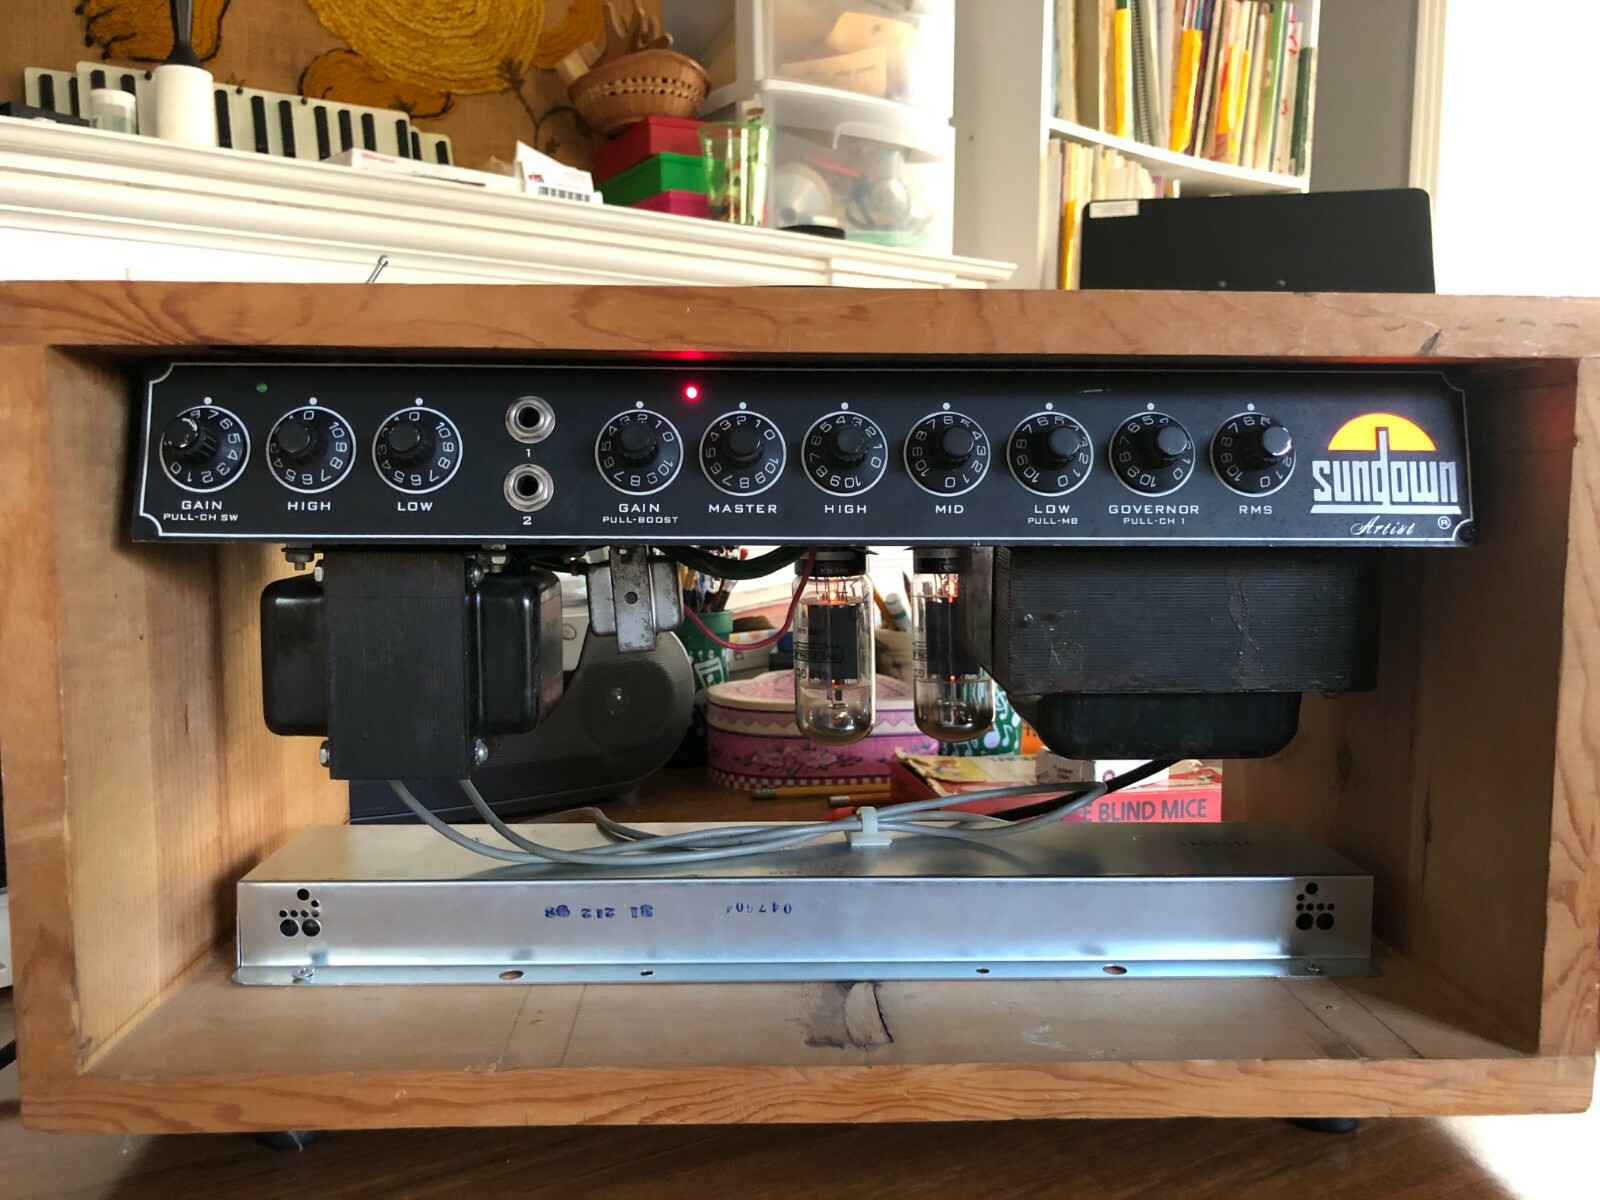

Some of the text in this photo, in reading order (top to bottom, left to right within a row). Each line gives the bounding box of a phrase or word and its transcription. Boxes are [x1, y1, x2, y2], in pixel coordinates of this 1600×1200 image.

[208, 410, 220, 420] 7
[303, 410, 314, 420] 0
[409, 412, 420, 421] 0
[836, 416, 846, 424] 4
[943, 416, 953, 425] 6
[1142, 416, 1154, 425] 5
[220, 418, 233, 429] 6
[655, 420, 662, 428] 1
[720, 419, 731, 430] 3
[755, 419, 761, 428] 1
[926, 419, 936, 429] 7
[1037, 416, 1049, 426] 6
[1243, 416, 1255, 426] 6
[329, 422, 345, 438] 10
[436, 422, 451, 438] 10
[609, 426, 618, 436] 4
[820, 422, 832, 433] 5
[865, 426, 876, 438] 2
[1022, 424, 1032, 434] 7
[1127, 422, 1140, 433] 6
[1228, 422, 1238, 433] 7
[227, 433, 240, 444] 5
[662, 432, 674, 442] 0
[711, 432, 720, 442] 4
[764, 429, 775, 440] 0
[916, 431, 927, 441] 8
[972, 431, 982, 440] 4
[601, 441, 611, 451] 5
[811, 436, 822, 446] 6
[1016, 439, 1027, 449] 8
[1119, 436, 1130, 445] 7
[1221, 436, 1232, 447] 8
[336, 442, 347, 452] 9
[377, 444, 387, 455] 3
[443, 442, 454, 452] 9
[706, 447, 716, 458] 5
[976, 445, 986, 456] 3
[227, 450, 238, 460] 4
[526, 448, 531, 458] 1
[809, 452, 820, 462] 7
[1079, 453, 1088, 464] 2
[1119, 451, 1131, 463] 8
[274, 458, 283, 468] 4
[330, 457, 343, 469] 8
[438, 457, 451, 469] 8
[604, 456, 615, 469] 6
[871, 457, 881, 468] 0
[1016, 455, 1028, 465] 9
[171, 462, 182, 474] 0
[216, 462, 230, 476] 3
[658, 460, 673, 476] 10
[711, 462, 722, 475] 6
[765, 458, 779, 474] 10
[816, 465, 828, 478] 8
[915, 459, 930, 476] 10
[971, 460, 982, 473] 2
[1312, 430, 1458, 505] sundown
[187, 471, 192, 482] 1
[201, 471, 213, 483] 2
[285, 469, 296, 482] 5
[321, 469, 332, 482] 7
[394, 470, 405, 483] 5
[430, 470, 439, 482] 7
[614, 471, 624, 482] 7
[1024, 466, 1040, 483] 10
[1072, 469, 1080, 478] 1
[1127, 466, 1140, 478] 9
[1173, 468, 1183, 480] 0
[1227, 465, 1243, 481] 10
[1276, 470, 1283, 480] 1
[302, 474, 313, 485] 6
[410, 474, 422, 486] 6
[630, 475, 640, 486] 8
[647, 472, 658, 484] 9
[722, 475, 733, 486] 7
[740, 477, 749, 488] 8
[755, 472, 766, 484] 9
[830, 475, 841, 487] 9
[844, 476, 861, 488] 10
[945, 477, 955, 488] 0
[962, 474, 969, 484] 1
[1057, 475, 1068, 487] 0
[1140, 474, 1156, 488] 10
[1260, 476, 1270, 488] 0
[181, 500, 222, 510] GAIN
[287, 501, 332, 512] HIGH
[397, 501, 433, 512] LOW
[618, 504, 660, 513] GAIN
[708, 504, 778, 514] MASTER
[824, 504, 868, 514] HIGH
[935, 504, 964, 514] MID
[1034, 504, 1071, 514] LOW
[1108, 504, 1200, 514] GOVERNOR
[1238, 505, 1272, 515] RMS
[163, 513, 238, 522] PULL-CH SW
[522, 516, 532, 526] 2
[602, 516, 679, 524] PULL-BOOST
[1123, 517, 1176, 525] PULL-CH
[1350, 516, 1416, 536] Artist
[1098, 800, 1156, 822] BLIND
[1161, 798, 1207, 820] MICE
[581, 906, 616, 919] 212
